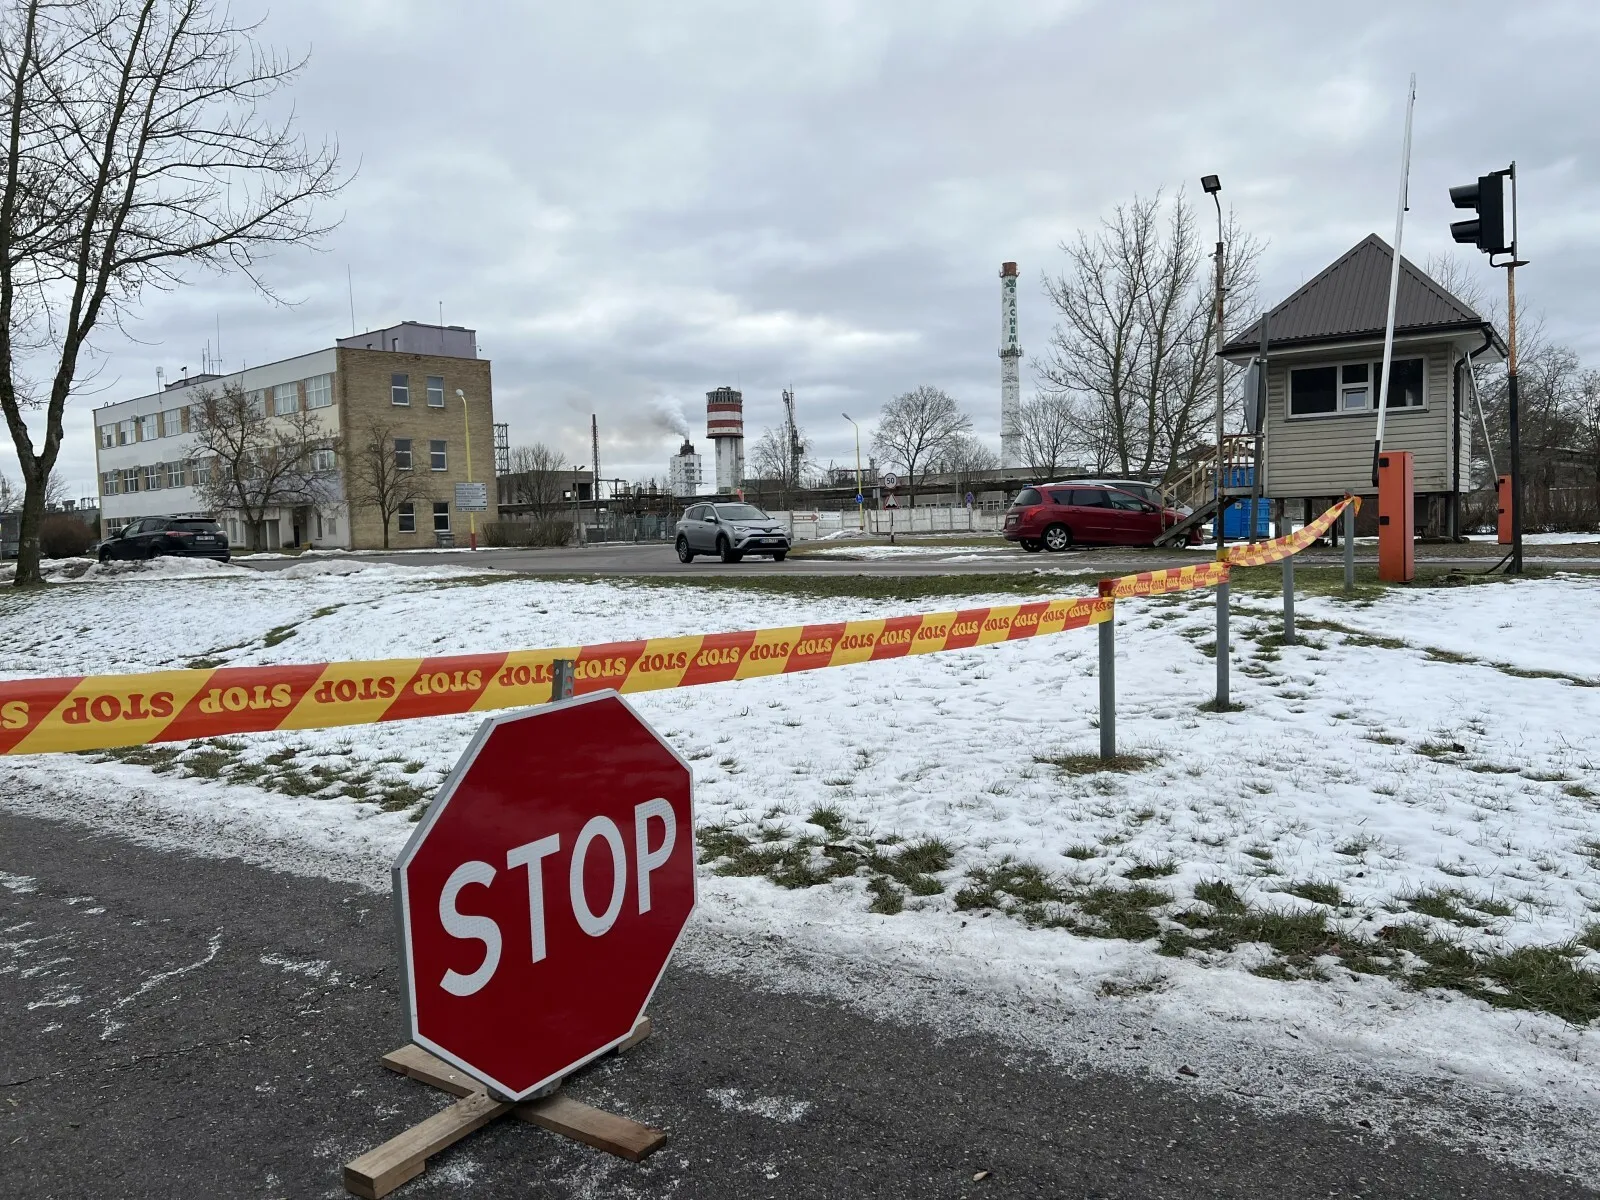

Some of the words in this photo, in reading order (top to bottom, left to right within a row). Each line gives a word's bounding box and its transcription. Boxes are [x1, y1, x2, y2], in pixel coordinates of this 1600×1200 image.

[1008, 299, 1017, 352] ACHEMA
[886, 477, 895, 485] 50
[1014, 612, 1038, 627] STOP
[1042, 608, 1065, 623] STOP
[1068, 603, 1091, 618] STOP
[917, 625, 947, 641] STOP
[951, 620, 979, 636] STOP
[984, 616, 1009, 631] STOP
[840, 633, 875, 650] STOP
[880, 628, 911, 645] STOP
[749, 642, 790, 661] STOP
[797, 637, 832, 656] STOP
[639, 651, 687, 673] STOP
[697, 646, 740, 667] STOP
[574, 657, 627, 680] STOP
[314, 676, 395, 704] STOP
[413, 669, 482, 695] STOP
[62, 692, 174, 724] STOP
[199, 684, 291, 714] STOP
[439, 797, 676, 997] STOP
